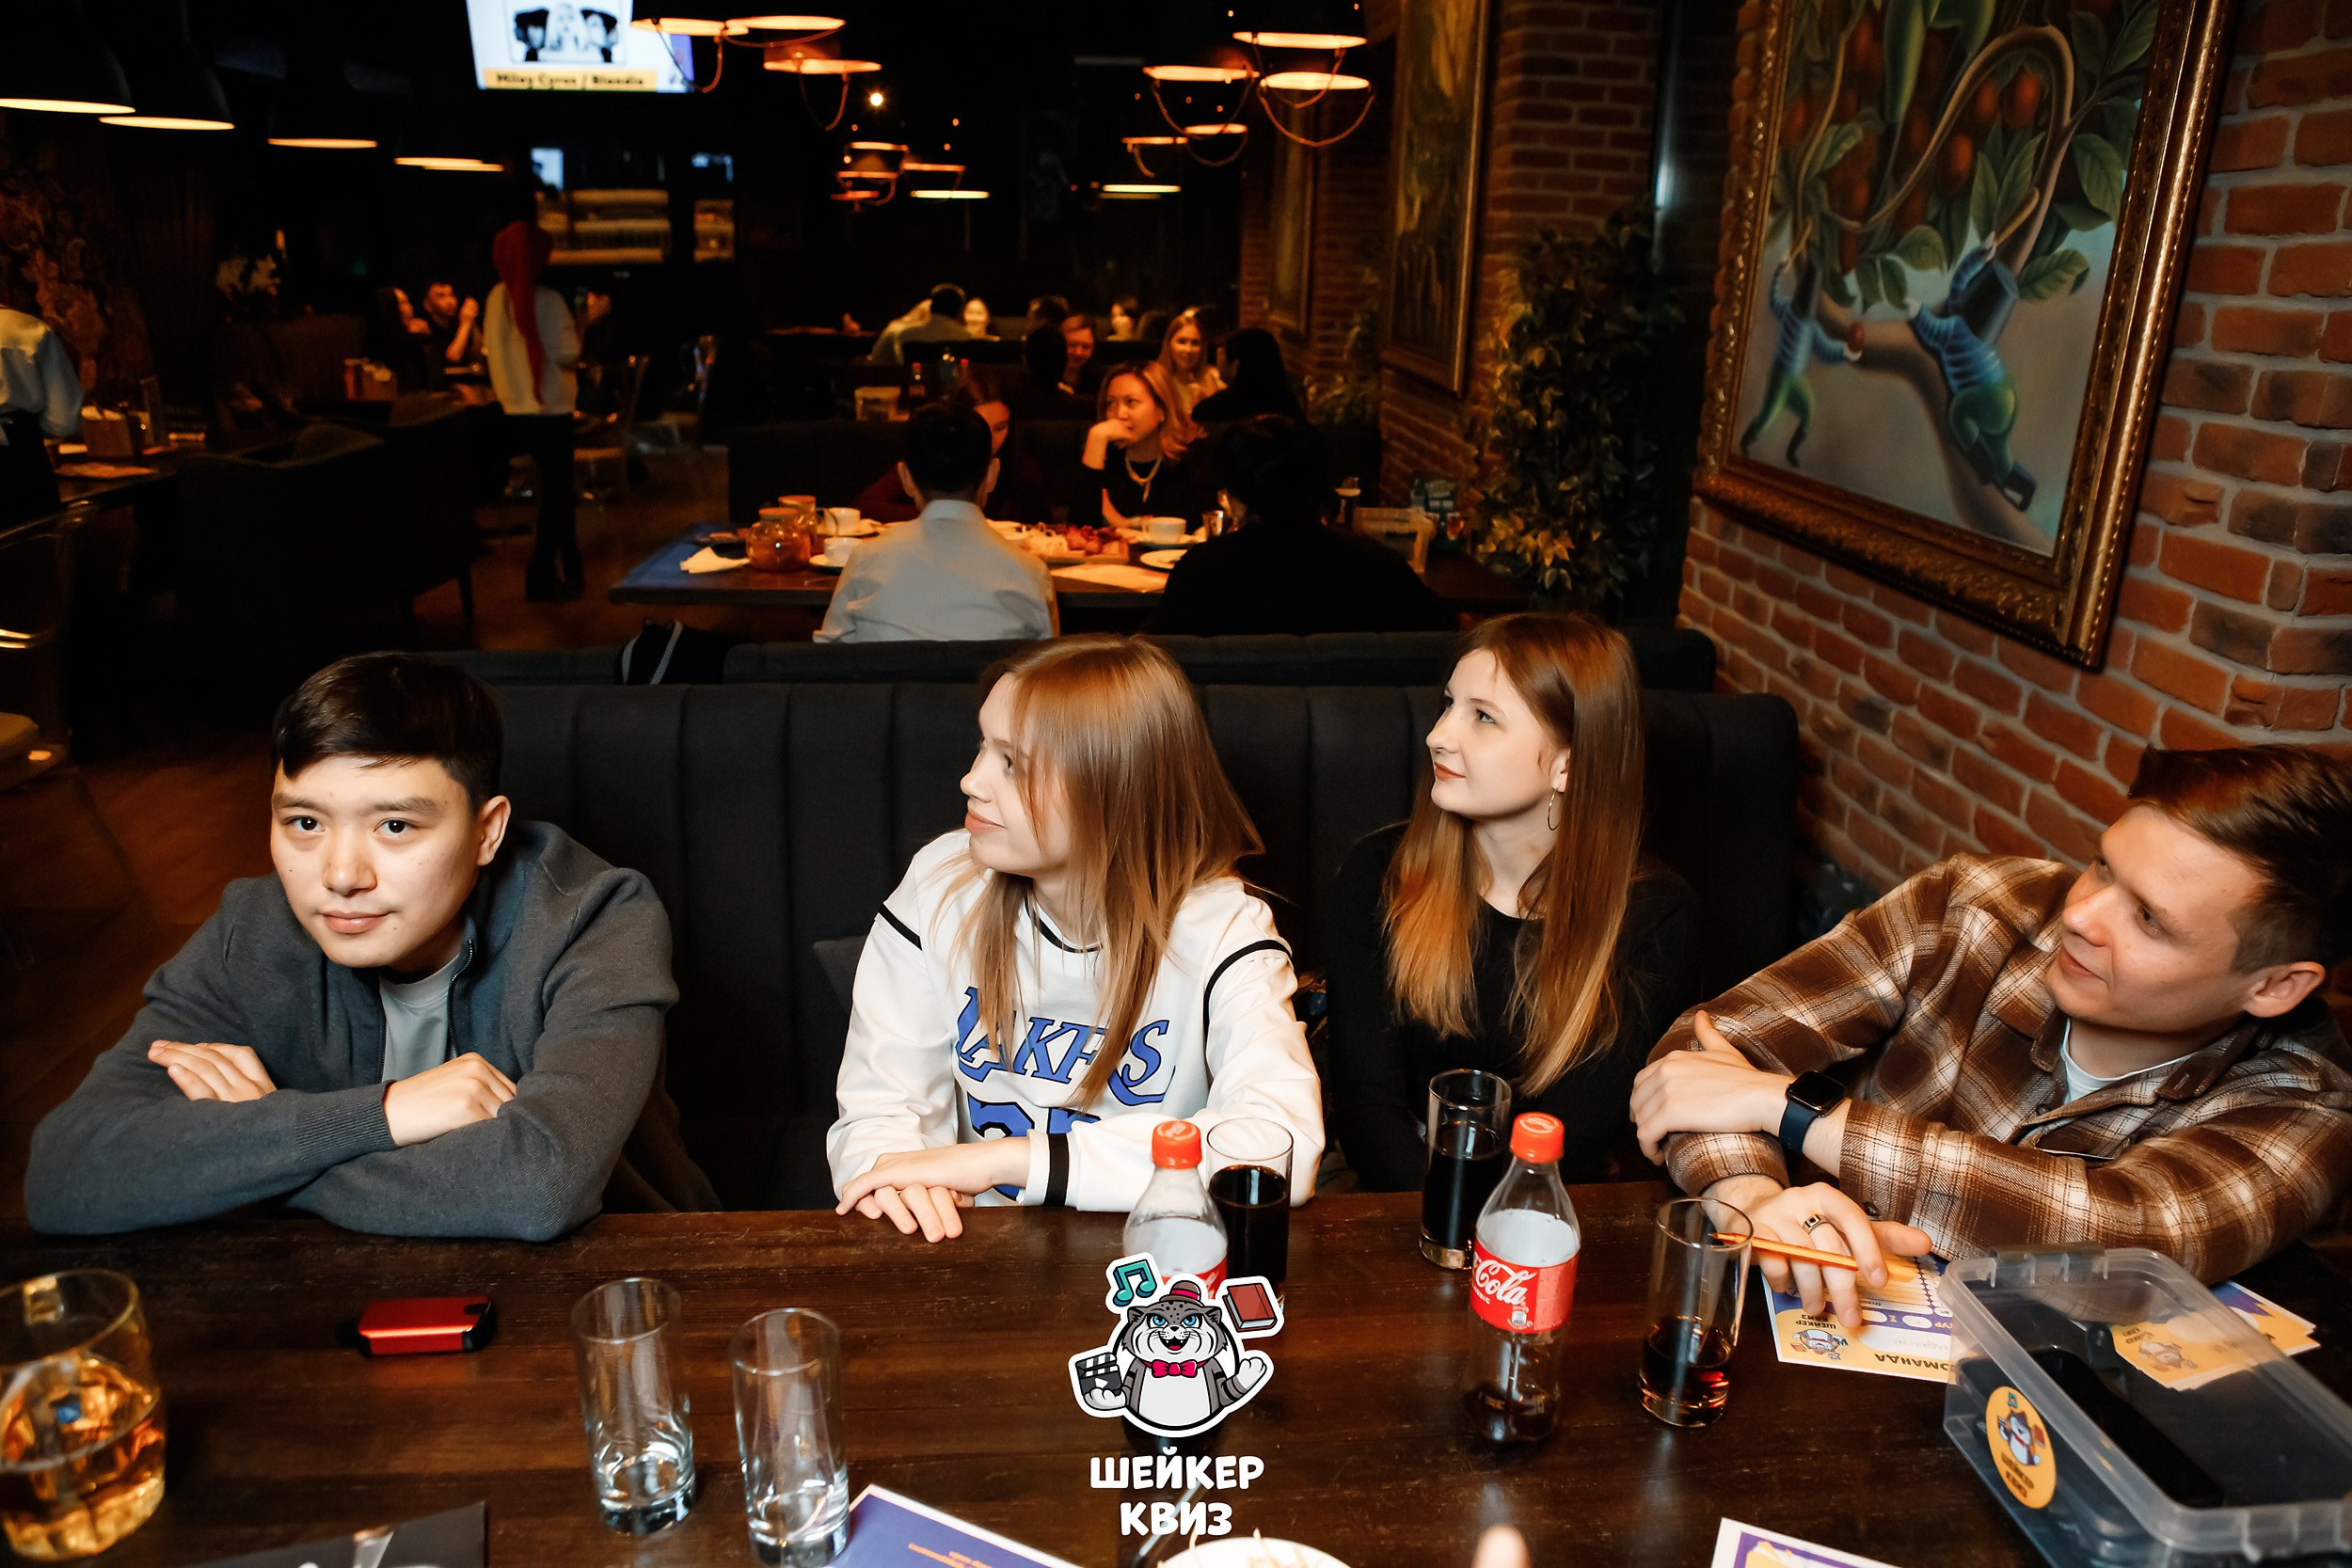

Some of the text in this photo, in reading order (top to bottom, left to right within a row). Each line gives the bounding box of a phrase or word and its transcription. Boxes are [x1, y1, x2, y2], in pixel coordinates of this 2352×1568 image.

[1801, 1314, 1828, 1323] КВИЗ
[1795, 1320, 1836, 1330] ШЕЙКЕР
[1874, 1353, 1956, 1371] ОМАНДА
